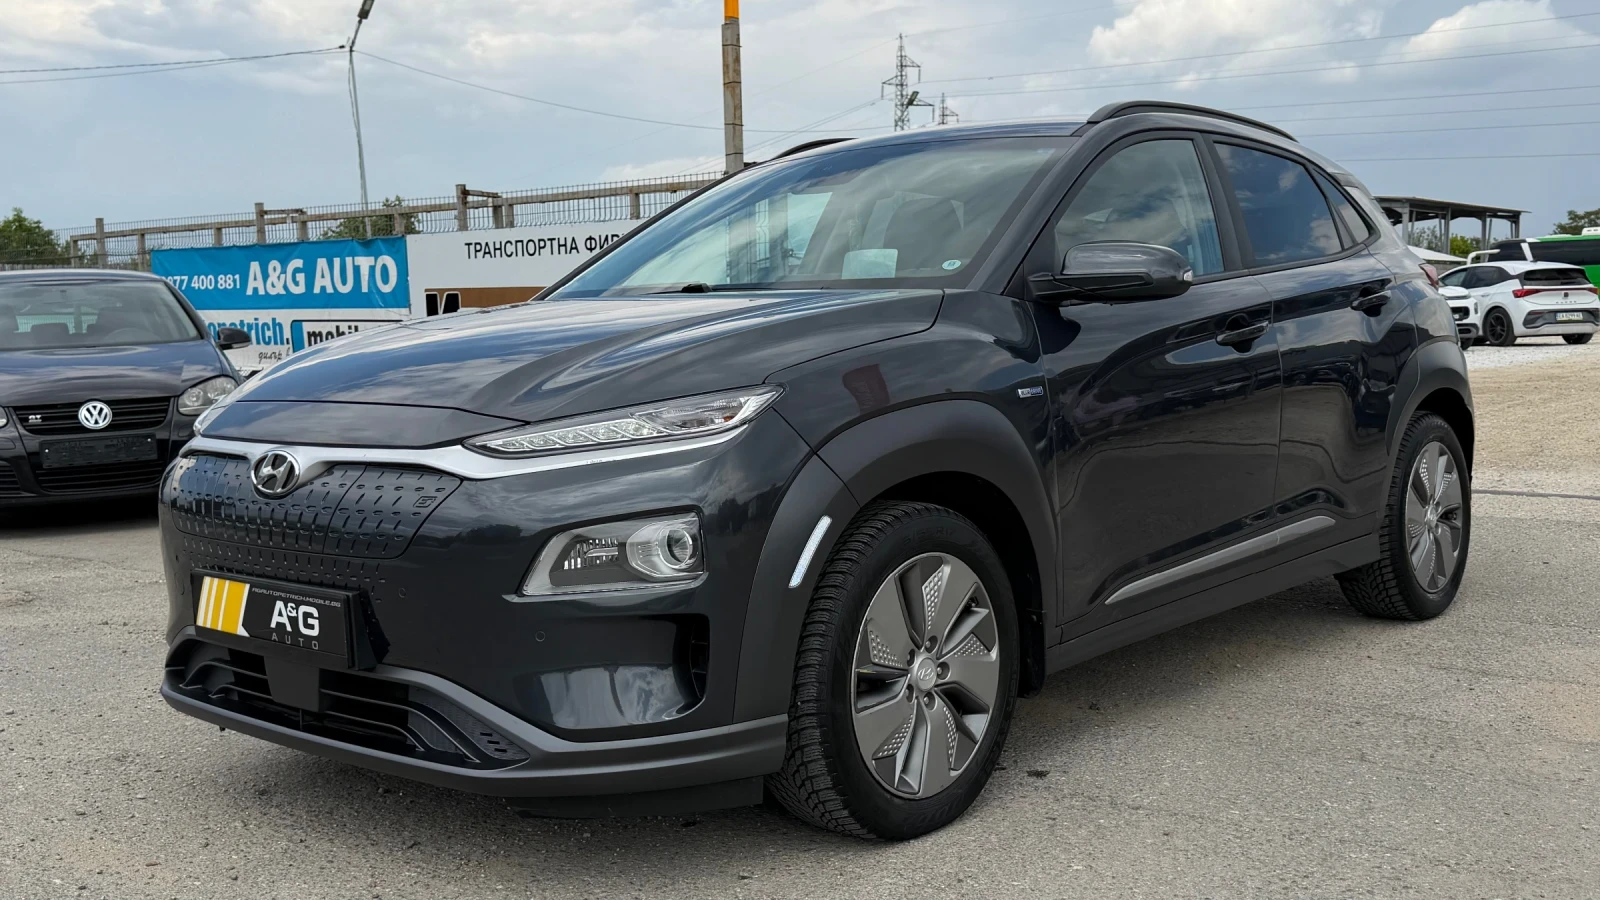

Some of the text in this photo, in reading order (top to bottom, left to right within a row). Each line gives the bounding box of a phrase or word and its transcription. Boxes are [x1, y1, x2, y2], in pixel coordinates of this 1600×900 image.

[464, 233, 624, 259] ТРАНСПОРТНА ФИР
[191, 275, 215, 290] 400
[218, 274, 240, 289] 881
[246, 255, 397, 295] A&G AUTO
[269, 600, 320, 637] A&G
[271, 632, 319, 650] AUTO
